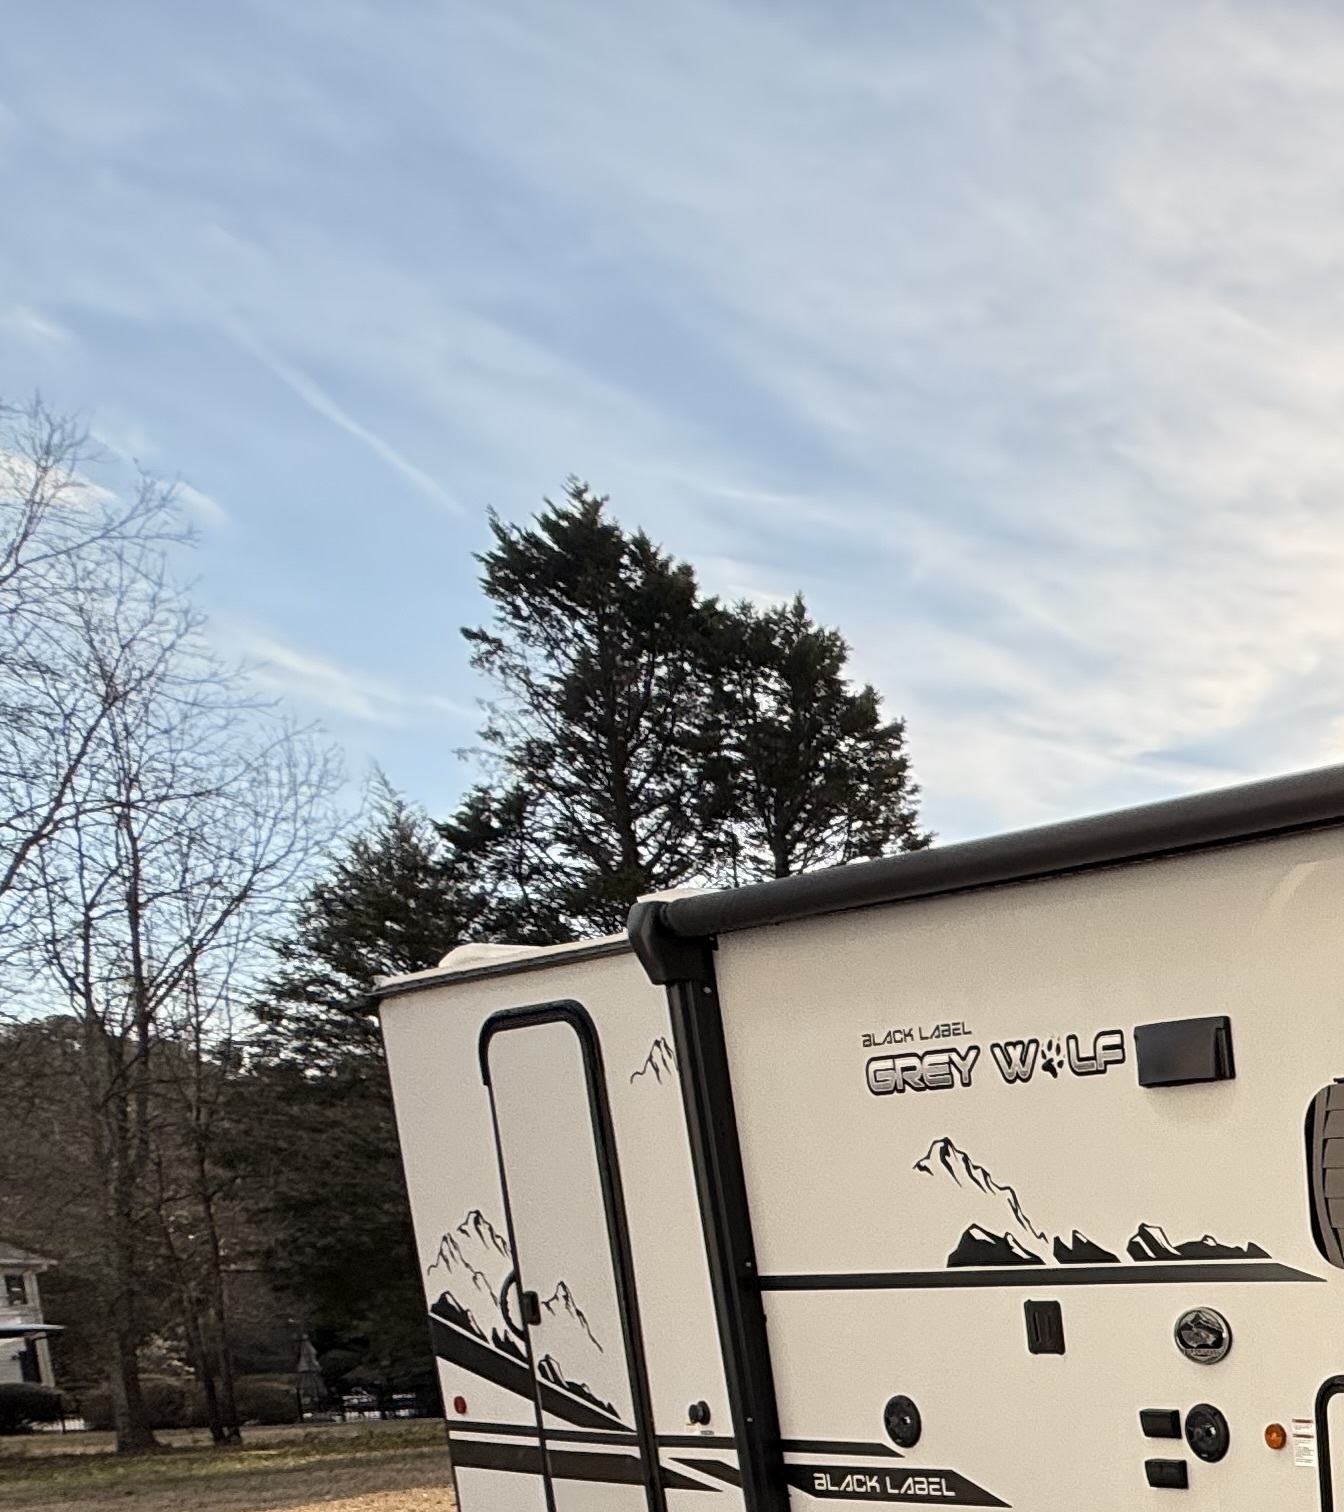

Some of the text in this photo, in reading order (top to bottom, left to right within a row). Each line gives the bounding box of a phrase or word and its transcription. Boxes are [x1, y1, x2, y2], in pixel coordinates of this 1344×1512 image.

[861, 1021, 972, 1047] BLACK LABEL
[865, 1045, 981, 1096] GREY
[812, 1472, 957, 1497] BLACK LABEL
